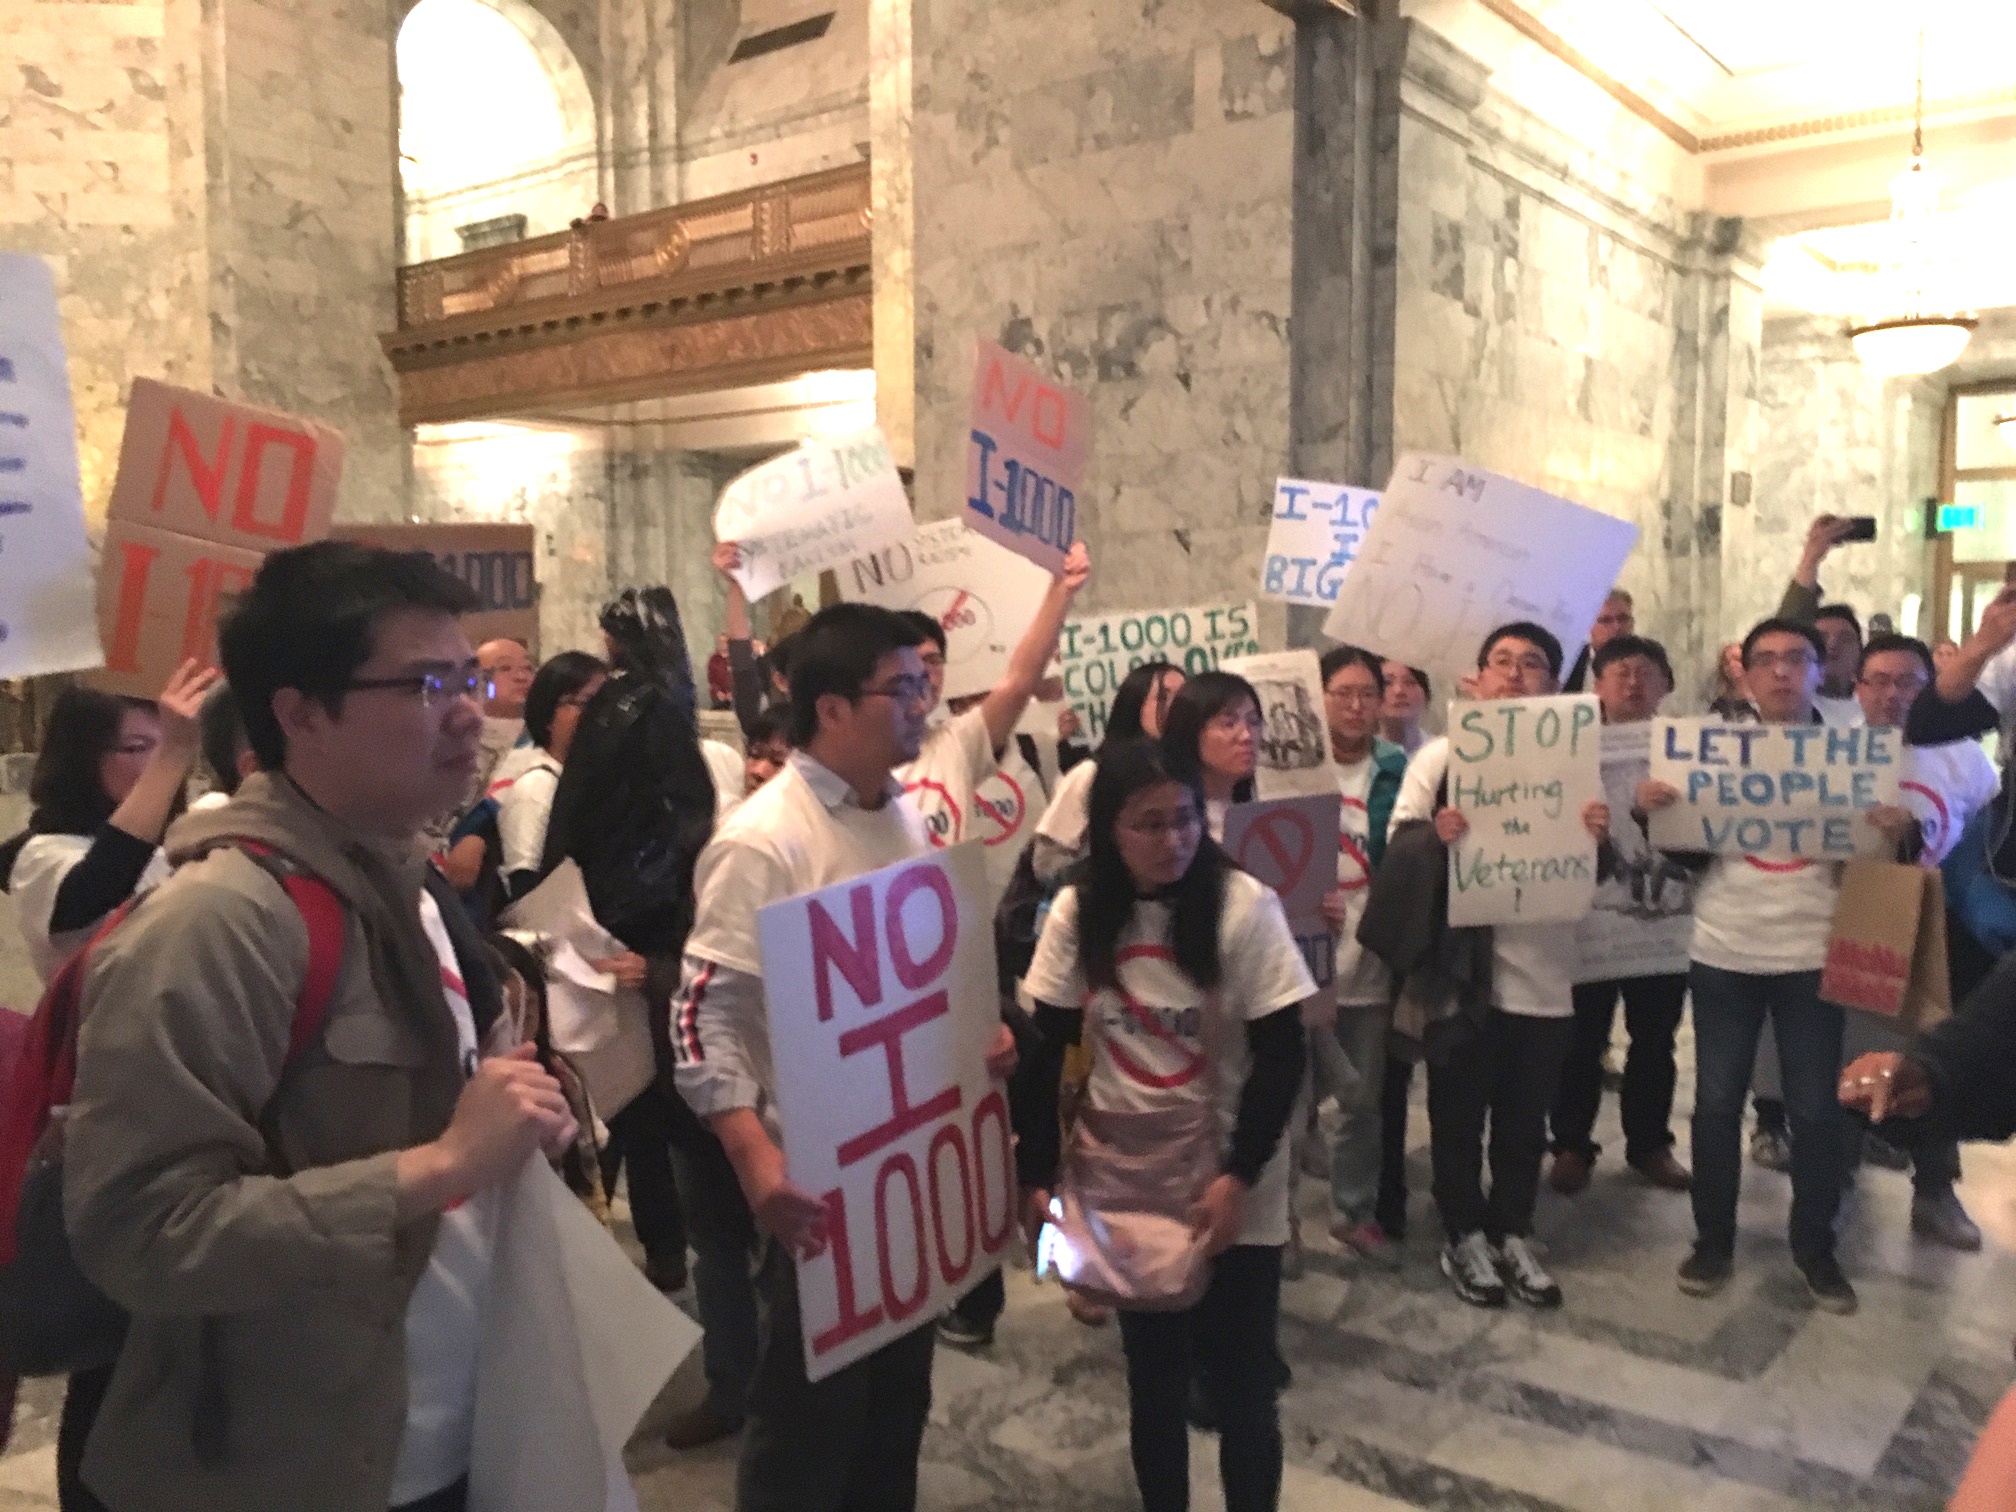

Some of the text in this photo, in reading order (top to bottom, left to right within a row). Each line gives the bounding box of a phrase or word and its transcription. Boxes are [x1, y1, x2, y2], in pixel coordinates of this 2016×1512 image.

[982, 361, 1067, 449] NO
[153, 407, 317, 543] NO
[968, 429, 1075, 554] I-1000
[1408, 459, 1487, 502] I AM
[851, 543, 914, 593] NO
[1265, 555, 1345, 600] BIG
[1061, 606, 1250, 659] I-1000 IS
[1454, 703, 1595, 762] STOP
[1665, 726, 1769, 767] LET
[1782, 726, 1893, 767] THE
[1454, 776, 1563, 820] Hurting
[1687, 769, 1879, 809] PEOPLE
[1502, 817, 1530, 840] the
[1701, 816, 1853, 852] VOTE
[1454, 848, 1591, 893] Veterans
[806, 864, 958, 1023] NO
[837, 989, 961, 1168] I
[804, 1092, 1019, 1357] 1000
